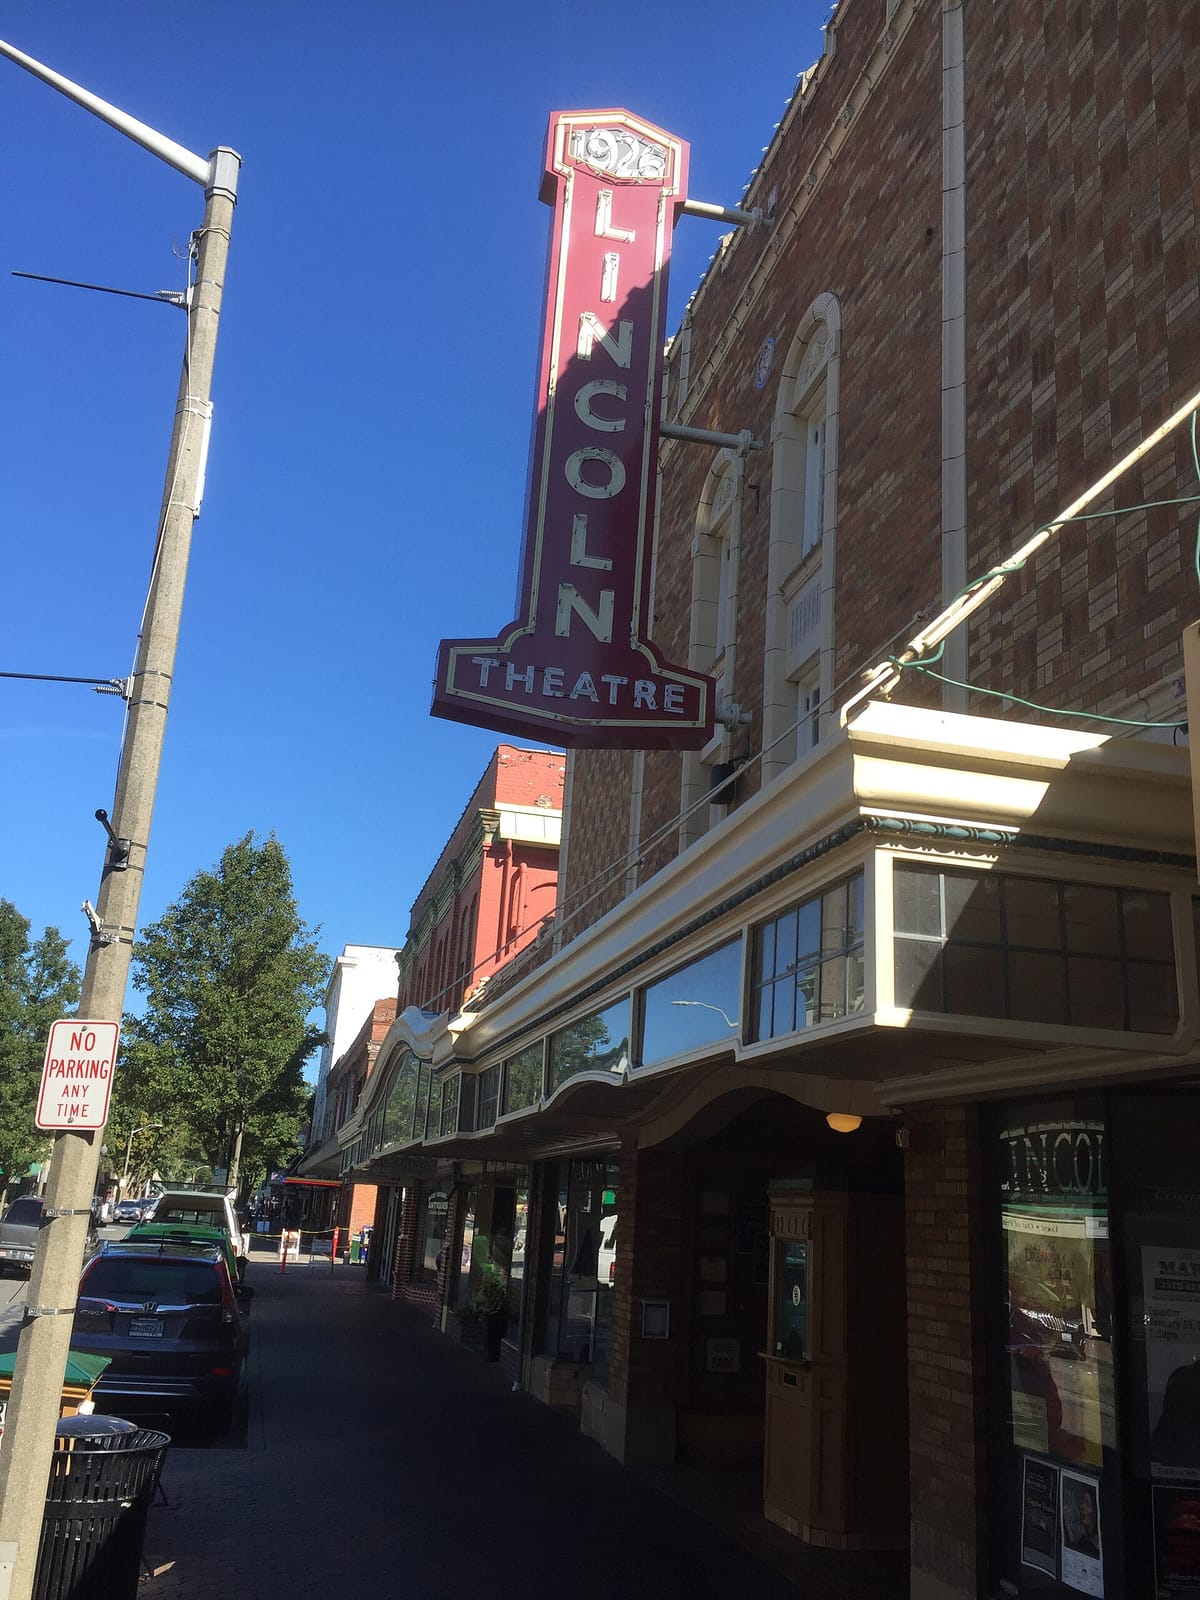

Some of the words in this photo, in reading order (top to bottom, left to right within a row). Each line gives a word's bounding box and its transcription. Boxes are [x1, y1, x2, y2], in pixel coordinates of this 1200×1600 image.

[574, 128, 665, 180] 1926
[555, 188, 636, 644] LINCOLN
[471, 655, 685, 714] THEATRE
[69, 1032, 96, 1052] NO
[48, 1059, 110, 1080] PARKING
[61, 1084, 90, 1098] ANY
[57, 1103, 89, 1118] TIME
